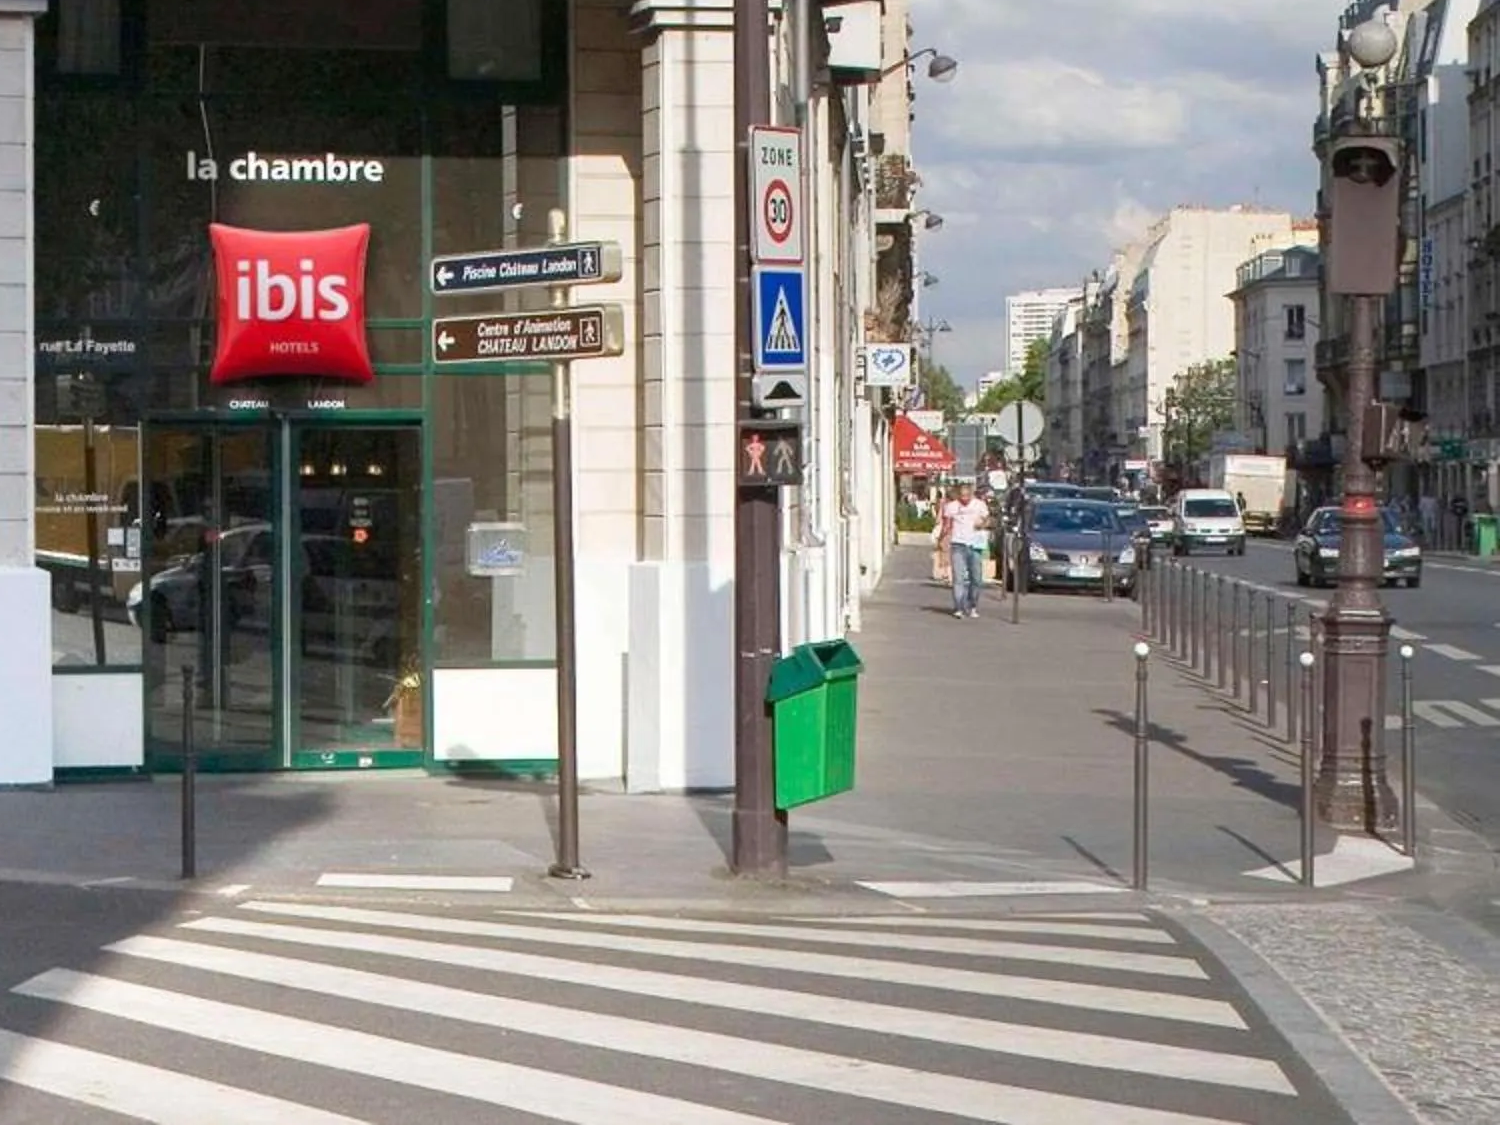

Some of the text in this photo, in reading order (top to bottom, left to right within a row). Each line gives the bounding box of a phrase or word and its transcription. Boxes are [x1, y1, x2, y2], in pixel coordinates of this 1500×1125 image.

[761, 146, 792, 166] ZONE
[187, 151, 384, 182] la chambre
[770, 198, 787, 223] 30
[462, 258, 577, 281] Piscine Château Landon
[236, 259, 349, 321] ibis
[477, 317, 571, 337] Centre d'Animation
[86, 340, 136, 355] Fayette
[270, 341, 319, 355] HOTELS
[477, 334, 578, 355] CHATEAU LANDON
[308, 399, 345, 409] LANDON
